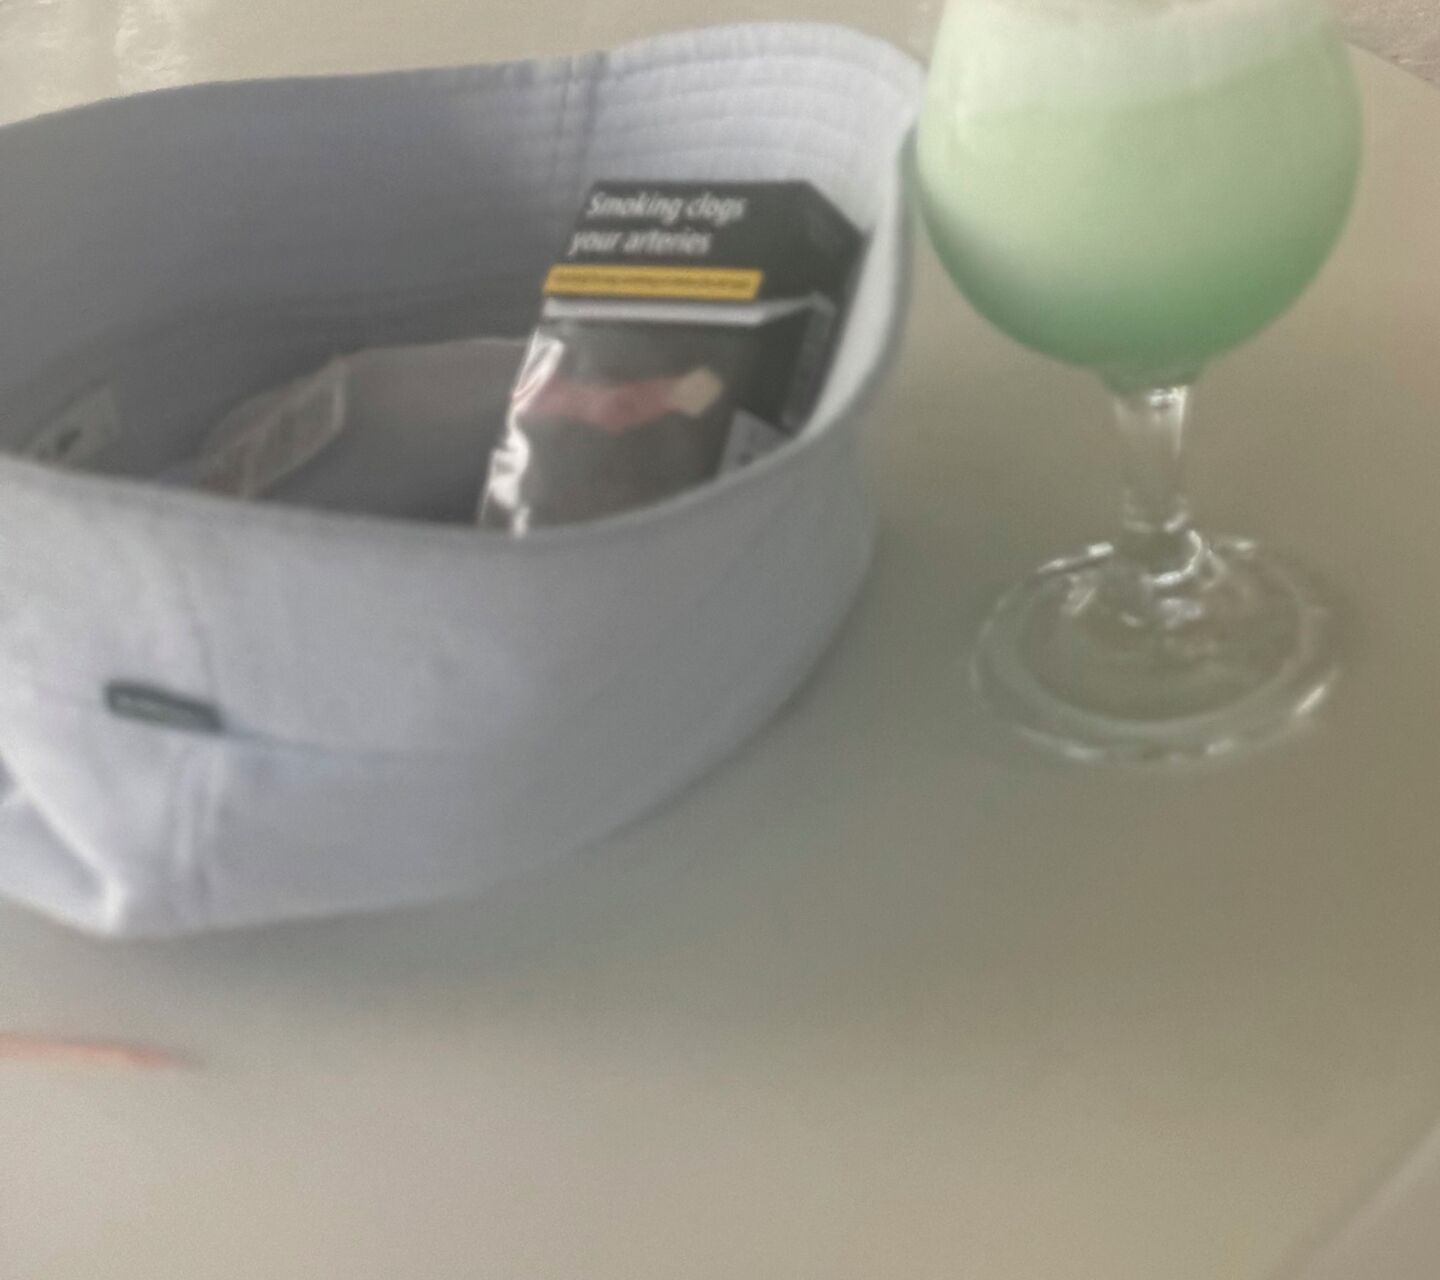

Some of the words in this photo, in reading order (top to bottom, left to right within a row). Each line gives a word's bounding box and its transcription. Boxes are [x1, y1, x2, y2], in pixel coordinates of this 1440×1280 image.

[587, 192, 683, 226] Smoking
[686, 192, 747, 227] clogs
[567, 231, 622, 257] your
[622, 228, 713, 256] arteries
